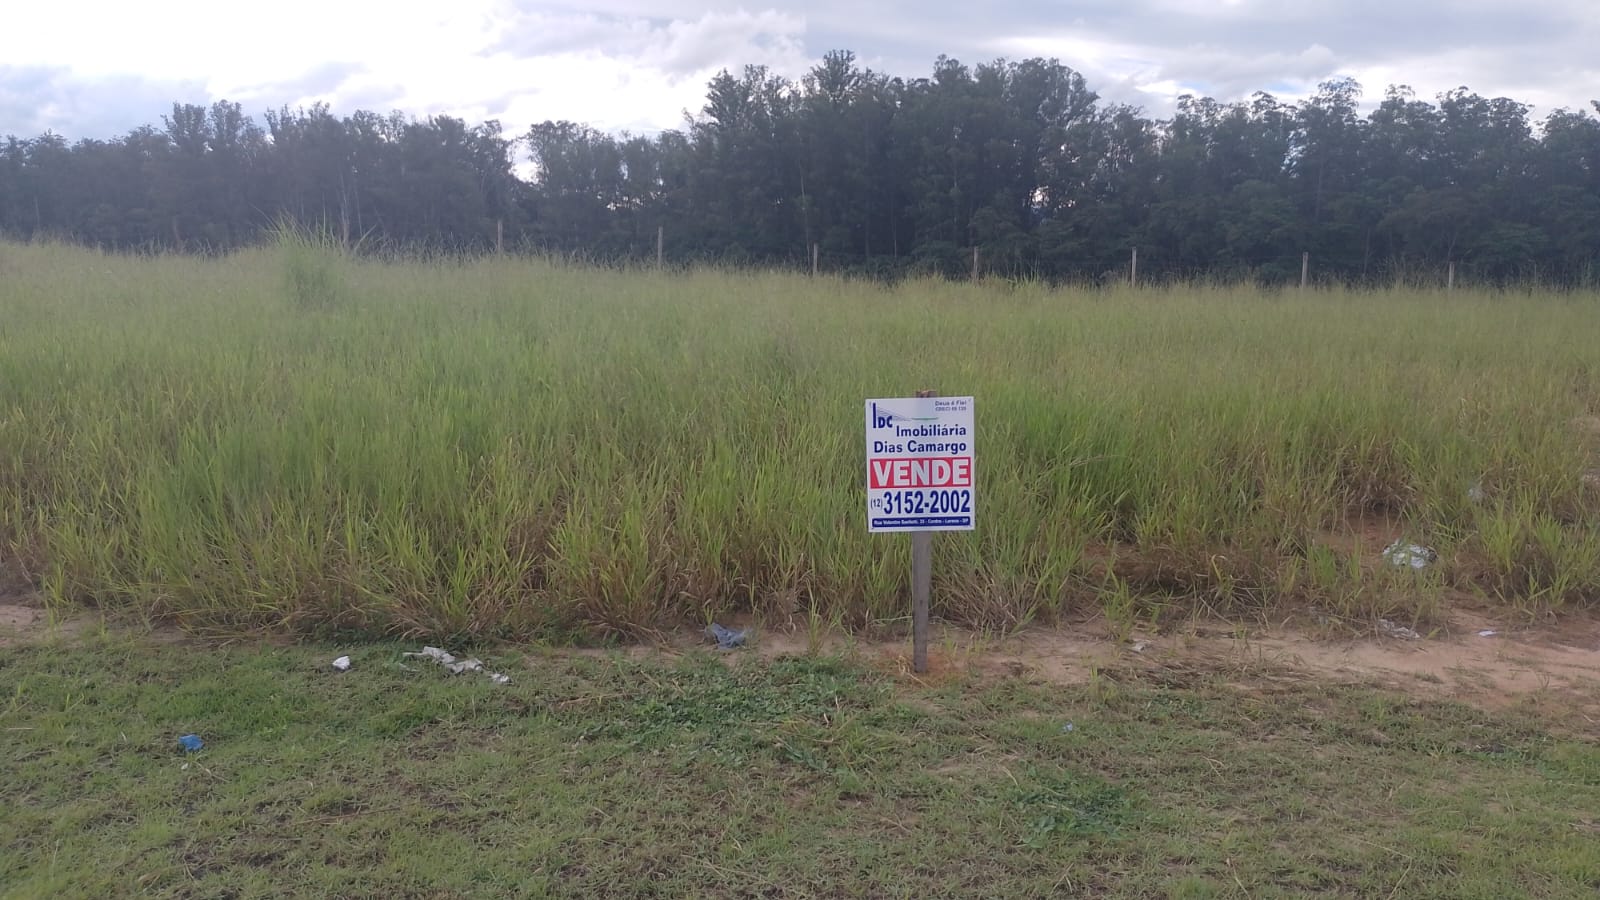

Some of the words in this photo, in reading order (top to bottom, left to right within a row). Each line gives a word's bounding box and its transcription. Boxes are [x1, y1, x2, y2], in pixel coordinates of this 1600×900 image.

[896, 424, 967, 437] Imobiliária
[874, 441, 903, 453] Dias
[907, 440, 967, 454] Camargo
[872, 459, 969, 487] VENDE
[870, 498, 882, 509] (12)
[883, 490, 970, 514] 3152-2002
